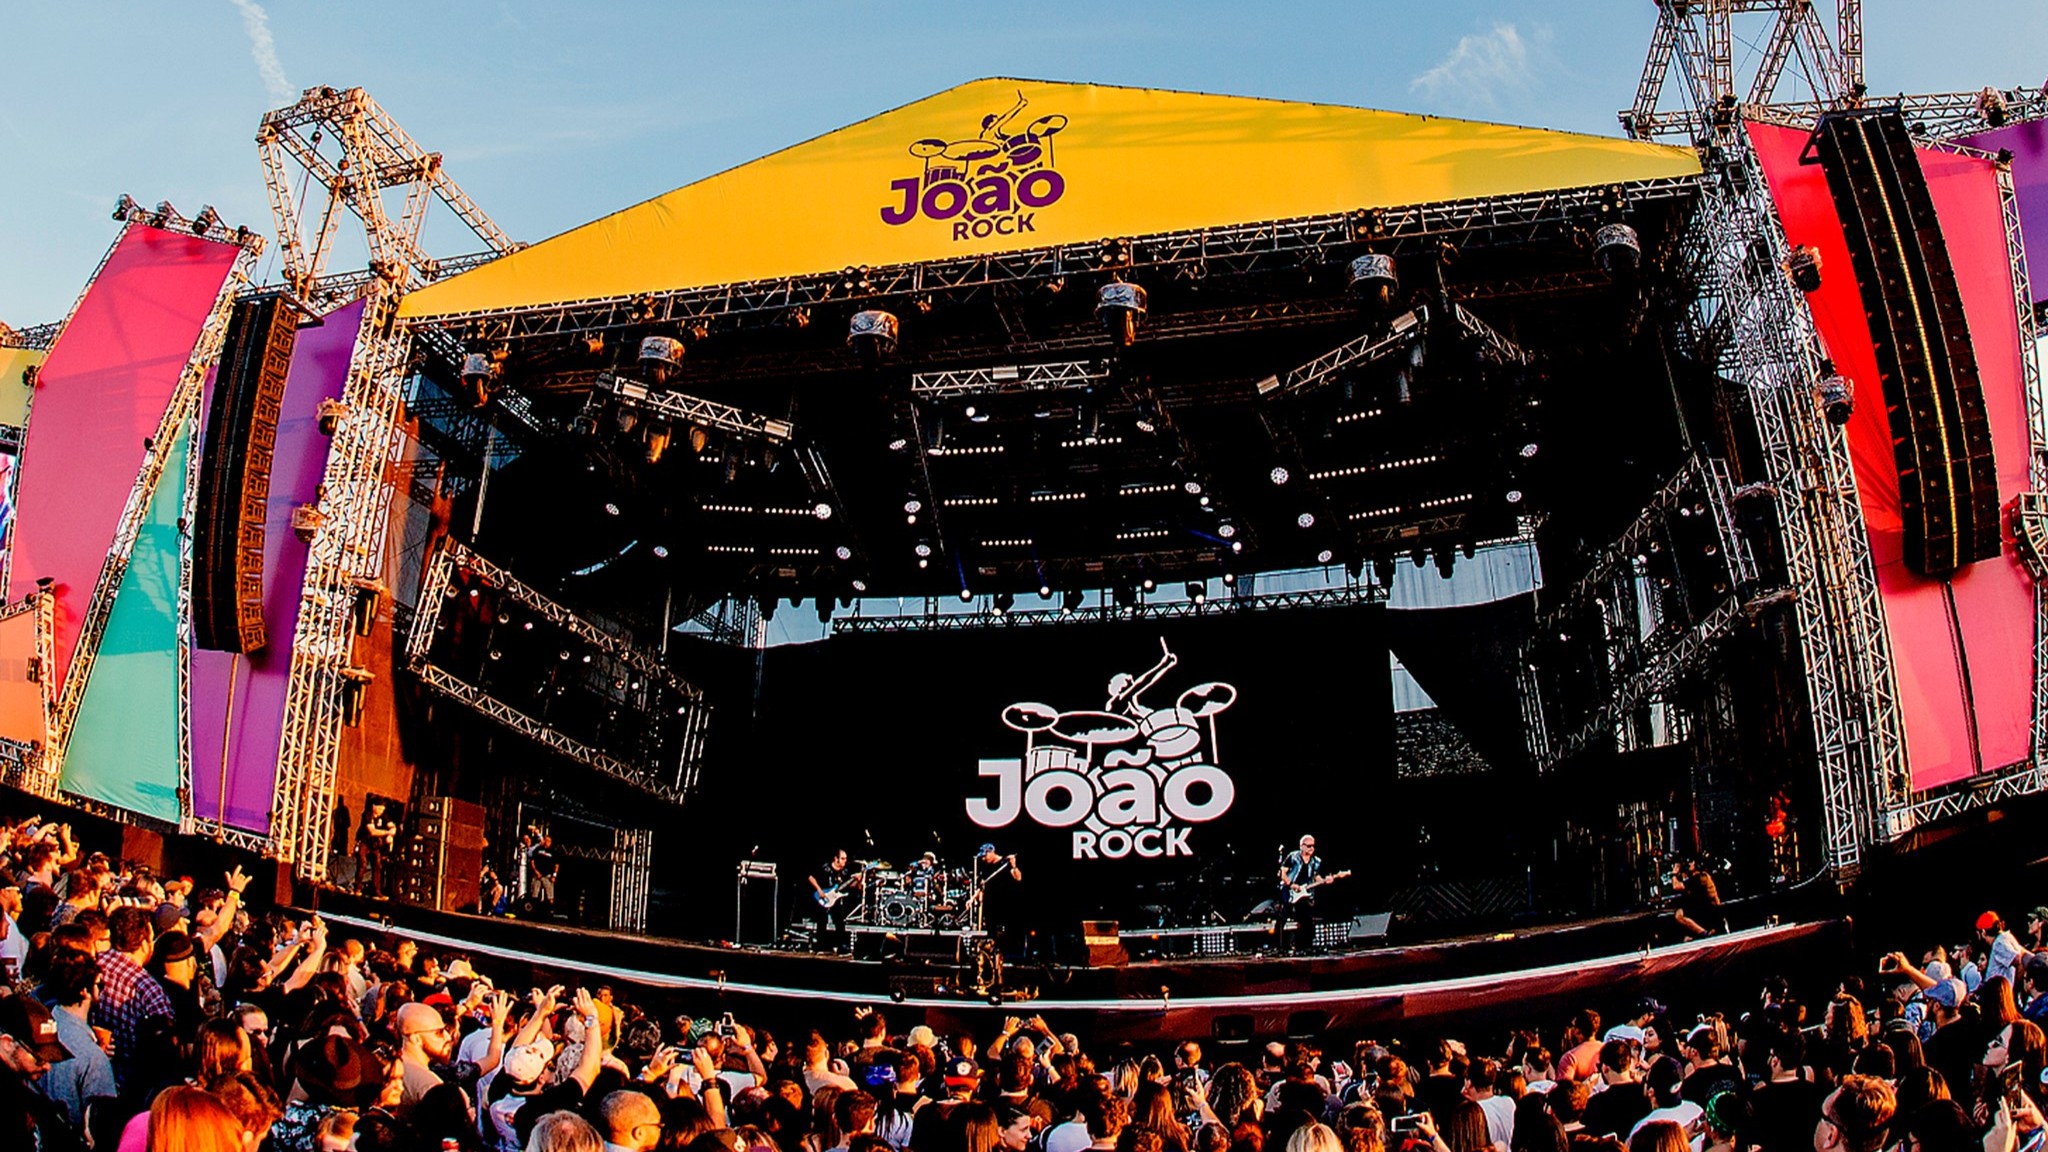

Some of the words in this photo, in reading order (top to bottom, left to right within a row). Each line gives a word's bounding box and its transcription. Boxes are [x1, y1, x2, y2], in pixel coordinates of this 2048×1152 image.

[880, 161, 1065, 226] João
[953, 213, 1036, 241] ROCK
[965, 749, 1235, 828] João
[1072, 827, 1193, 859] ROCK
